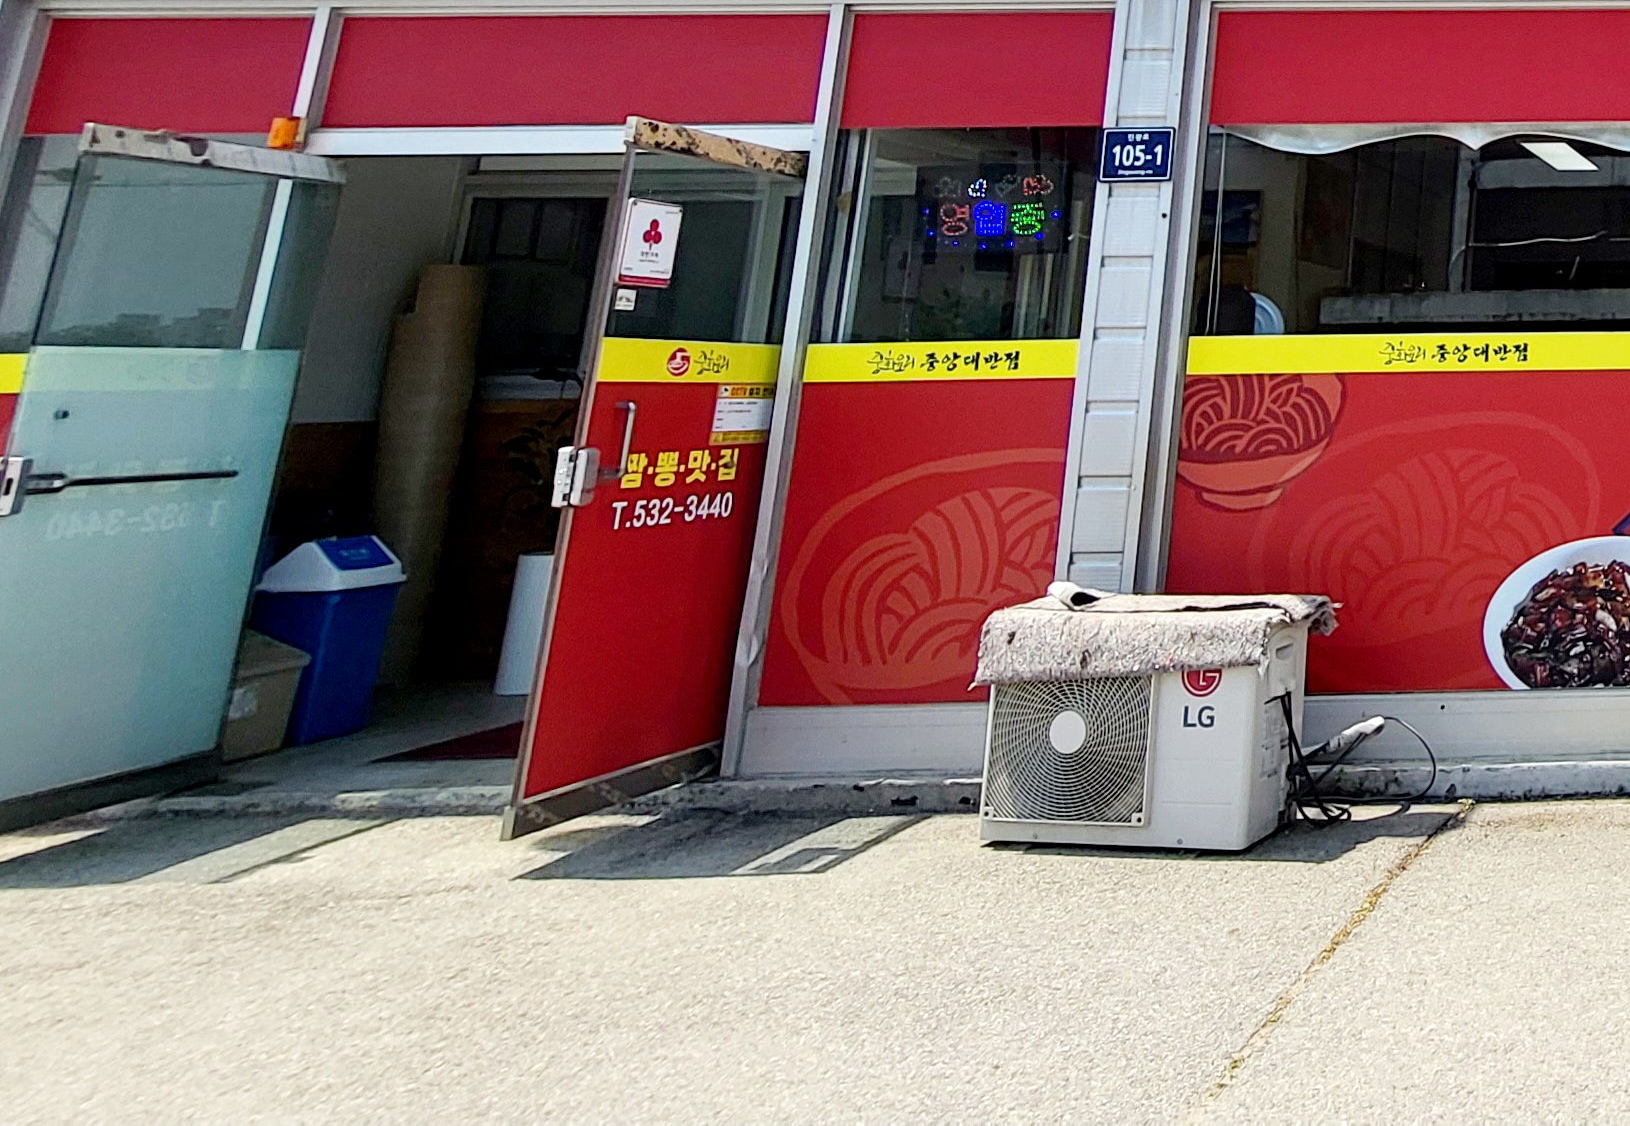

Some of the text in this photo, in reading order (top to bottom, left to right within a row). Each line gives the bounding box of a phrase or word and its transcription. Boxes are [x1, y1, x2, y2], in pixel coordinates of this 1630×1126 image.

[1112, 144, 1163, 166] 105-1
[940, 201, 1045, 236] 영업중
[866, 350, 1021, 375] 중화요리 중앙대반점
[1379, 341, 1529, 365] 중화요리 중앙대반점
[612, 491, 734, 530] T.532-3440
[1183, 705, 1216, 729] LG
